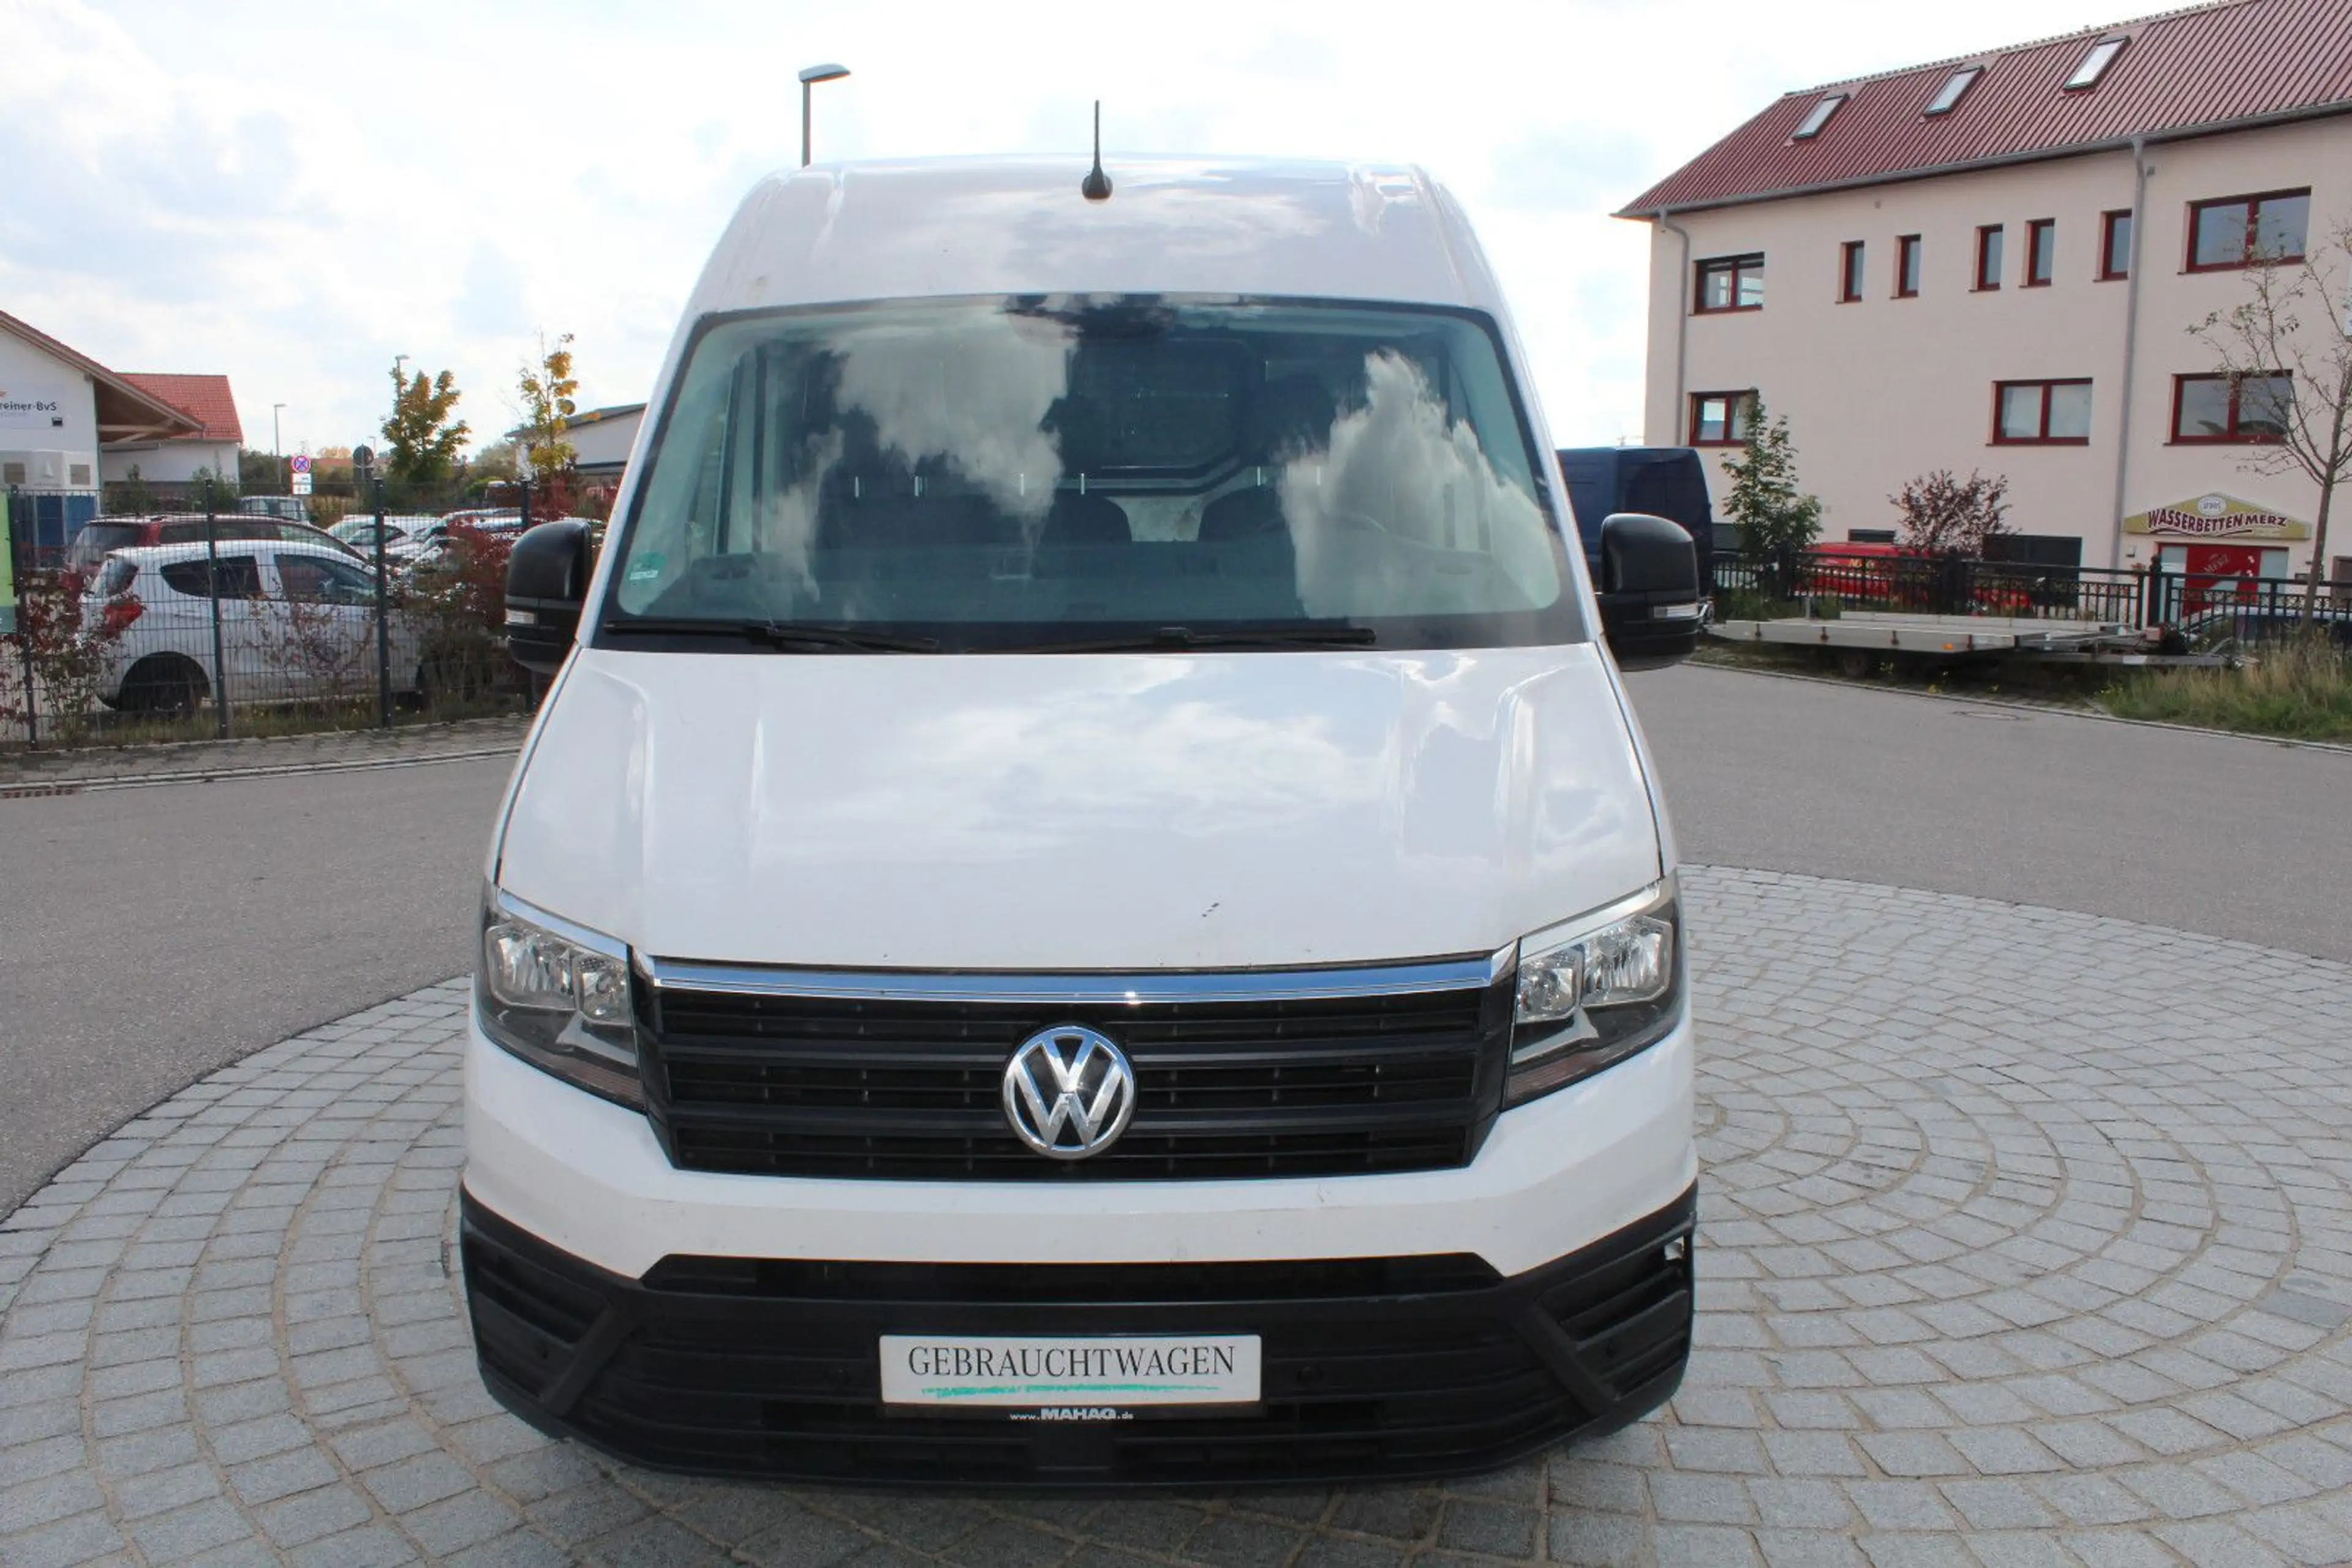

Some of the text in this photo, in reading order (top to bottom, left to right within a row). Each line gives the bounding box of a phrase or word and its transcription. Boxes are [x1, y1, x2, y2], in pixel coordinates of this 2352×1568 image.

[2147, 508, 2244, 532] WASSERBETTEN
[2245, 514, 2287, 527] MERZ
[1003, 1025, 1134, 1159] VW
[908, 1345, 1236, 1377] GEBRAUCHTWAGEN
[1010, 1408, 1133, 1420] www.MAHAG.de
